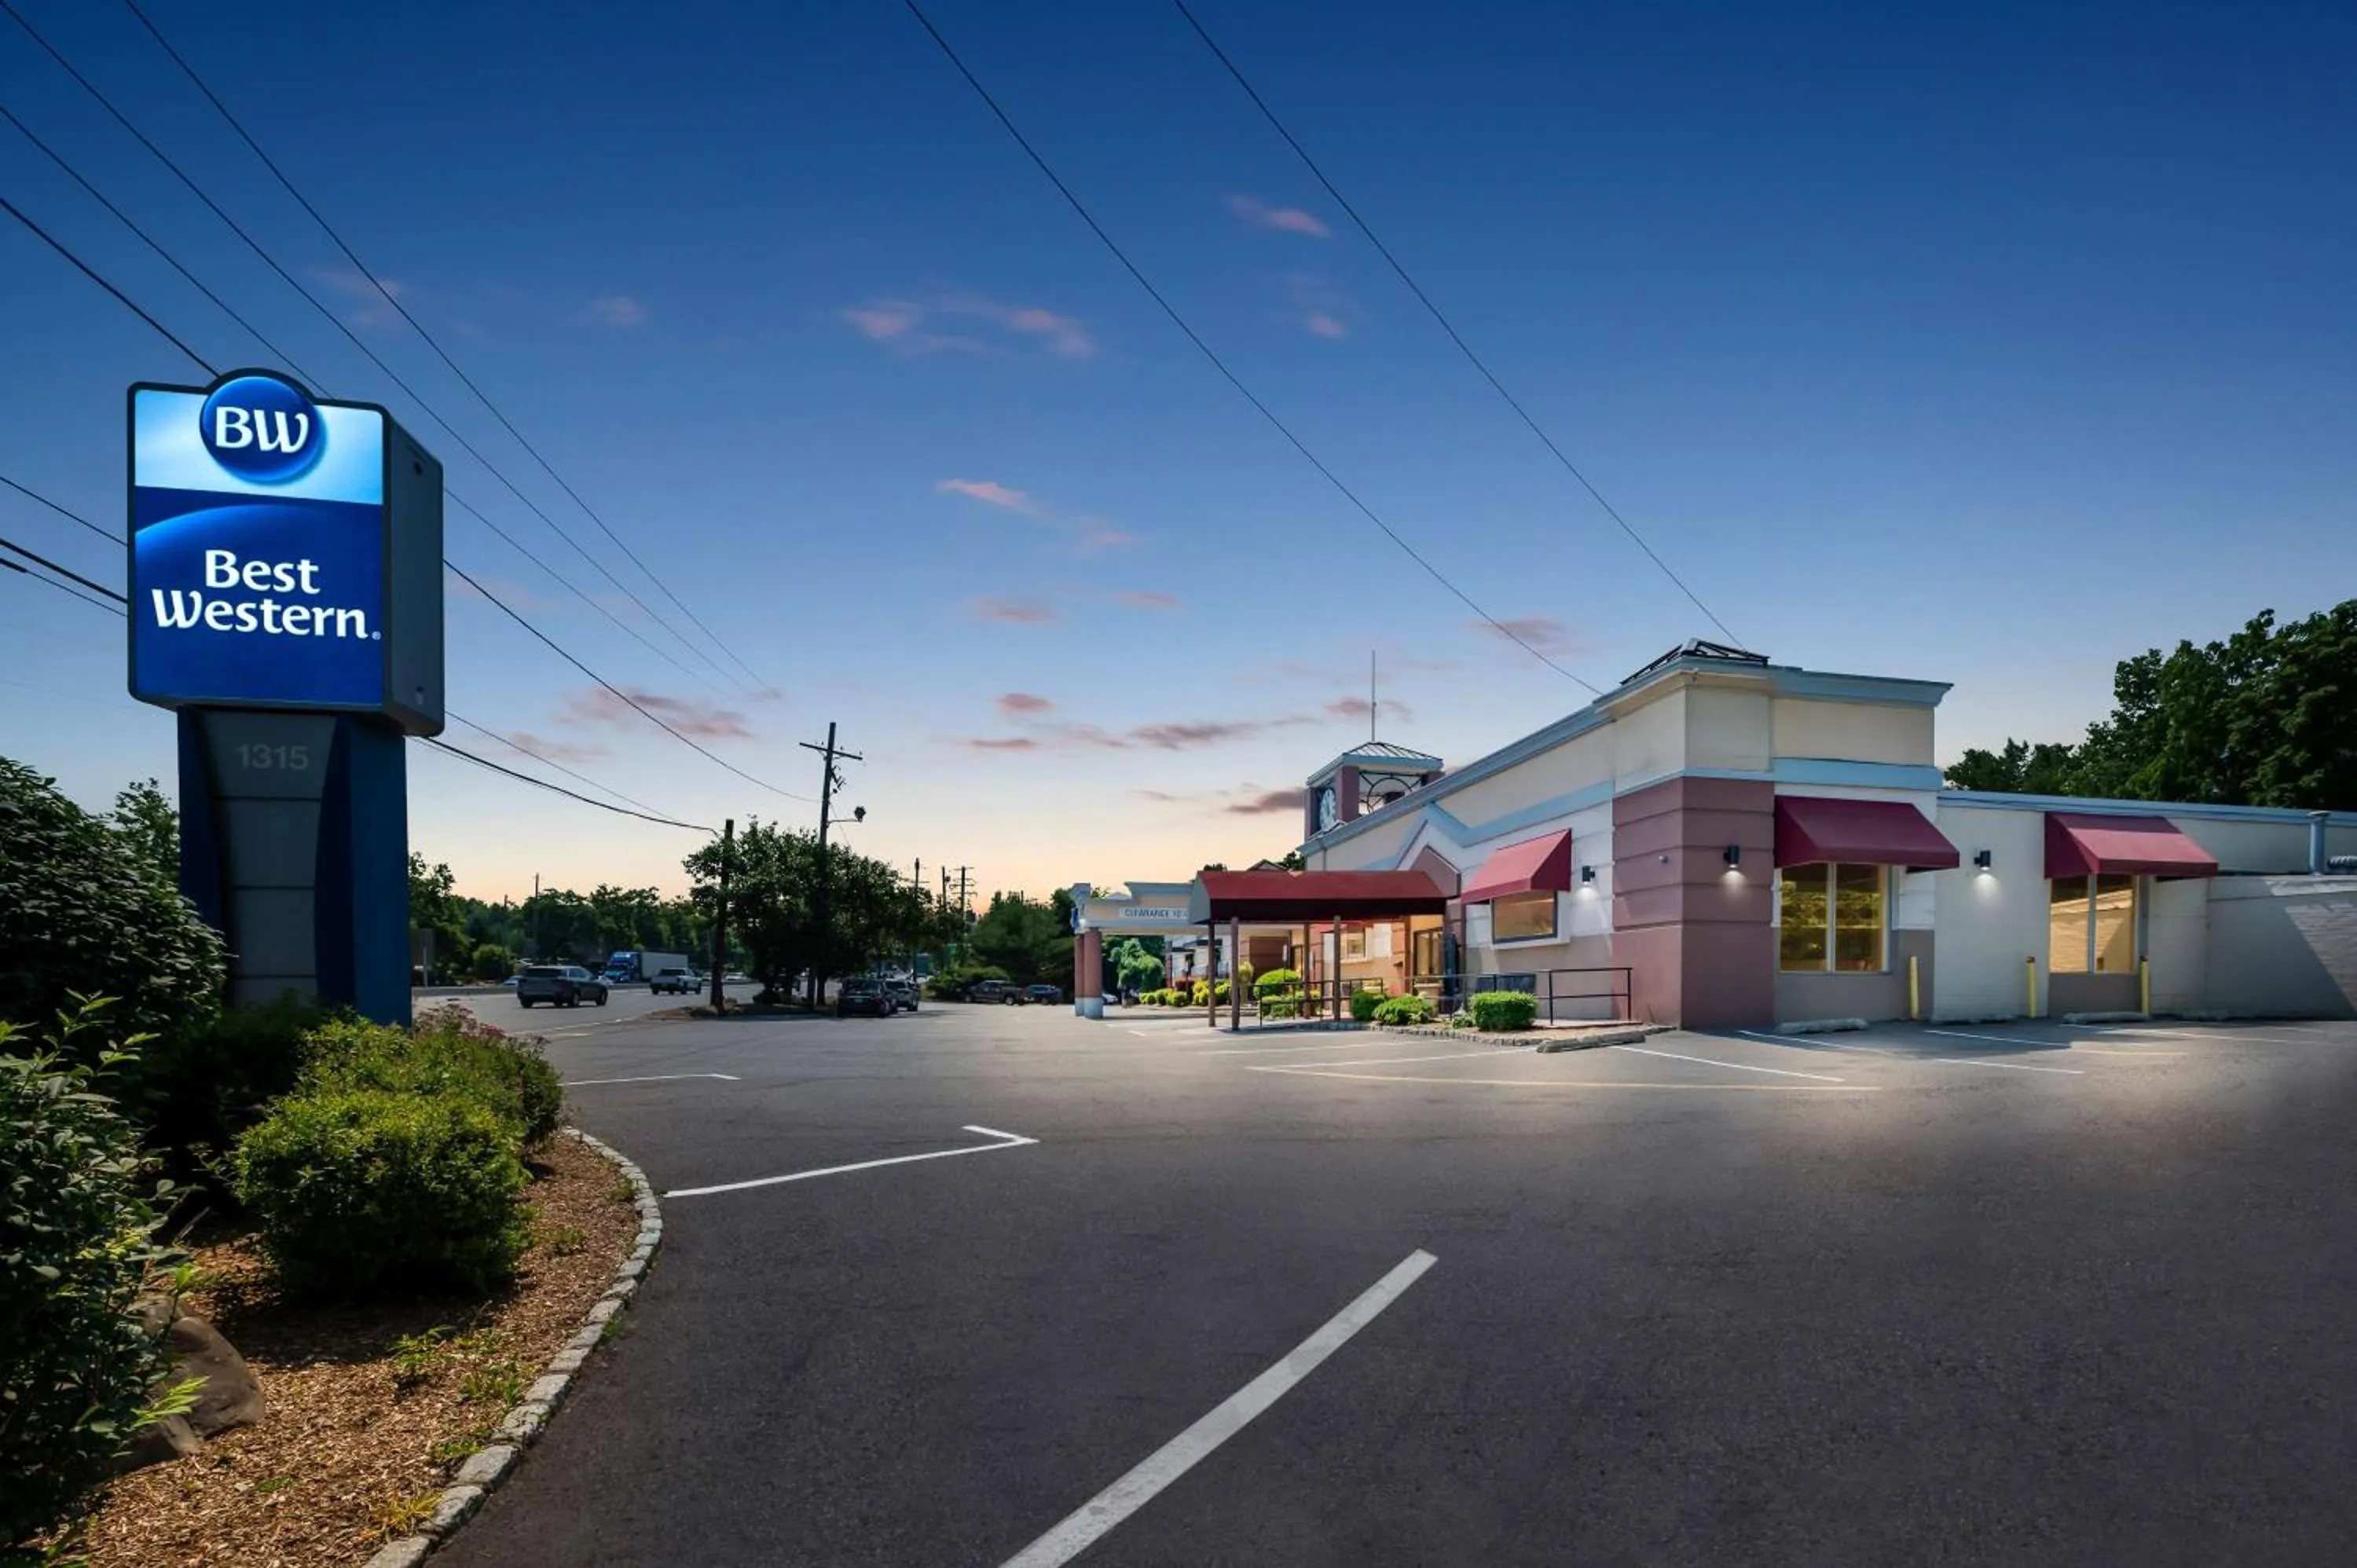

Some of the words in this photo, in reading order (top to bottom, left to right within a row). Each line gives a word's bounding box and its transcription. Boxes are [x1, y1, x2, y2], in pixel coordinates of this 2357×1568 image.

[214, 405, 310, 454] BW
[204, 549, 321, 595] Best
[236, 743, 309, 770] 1315
